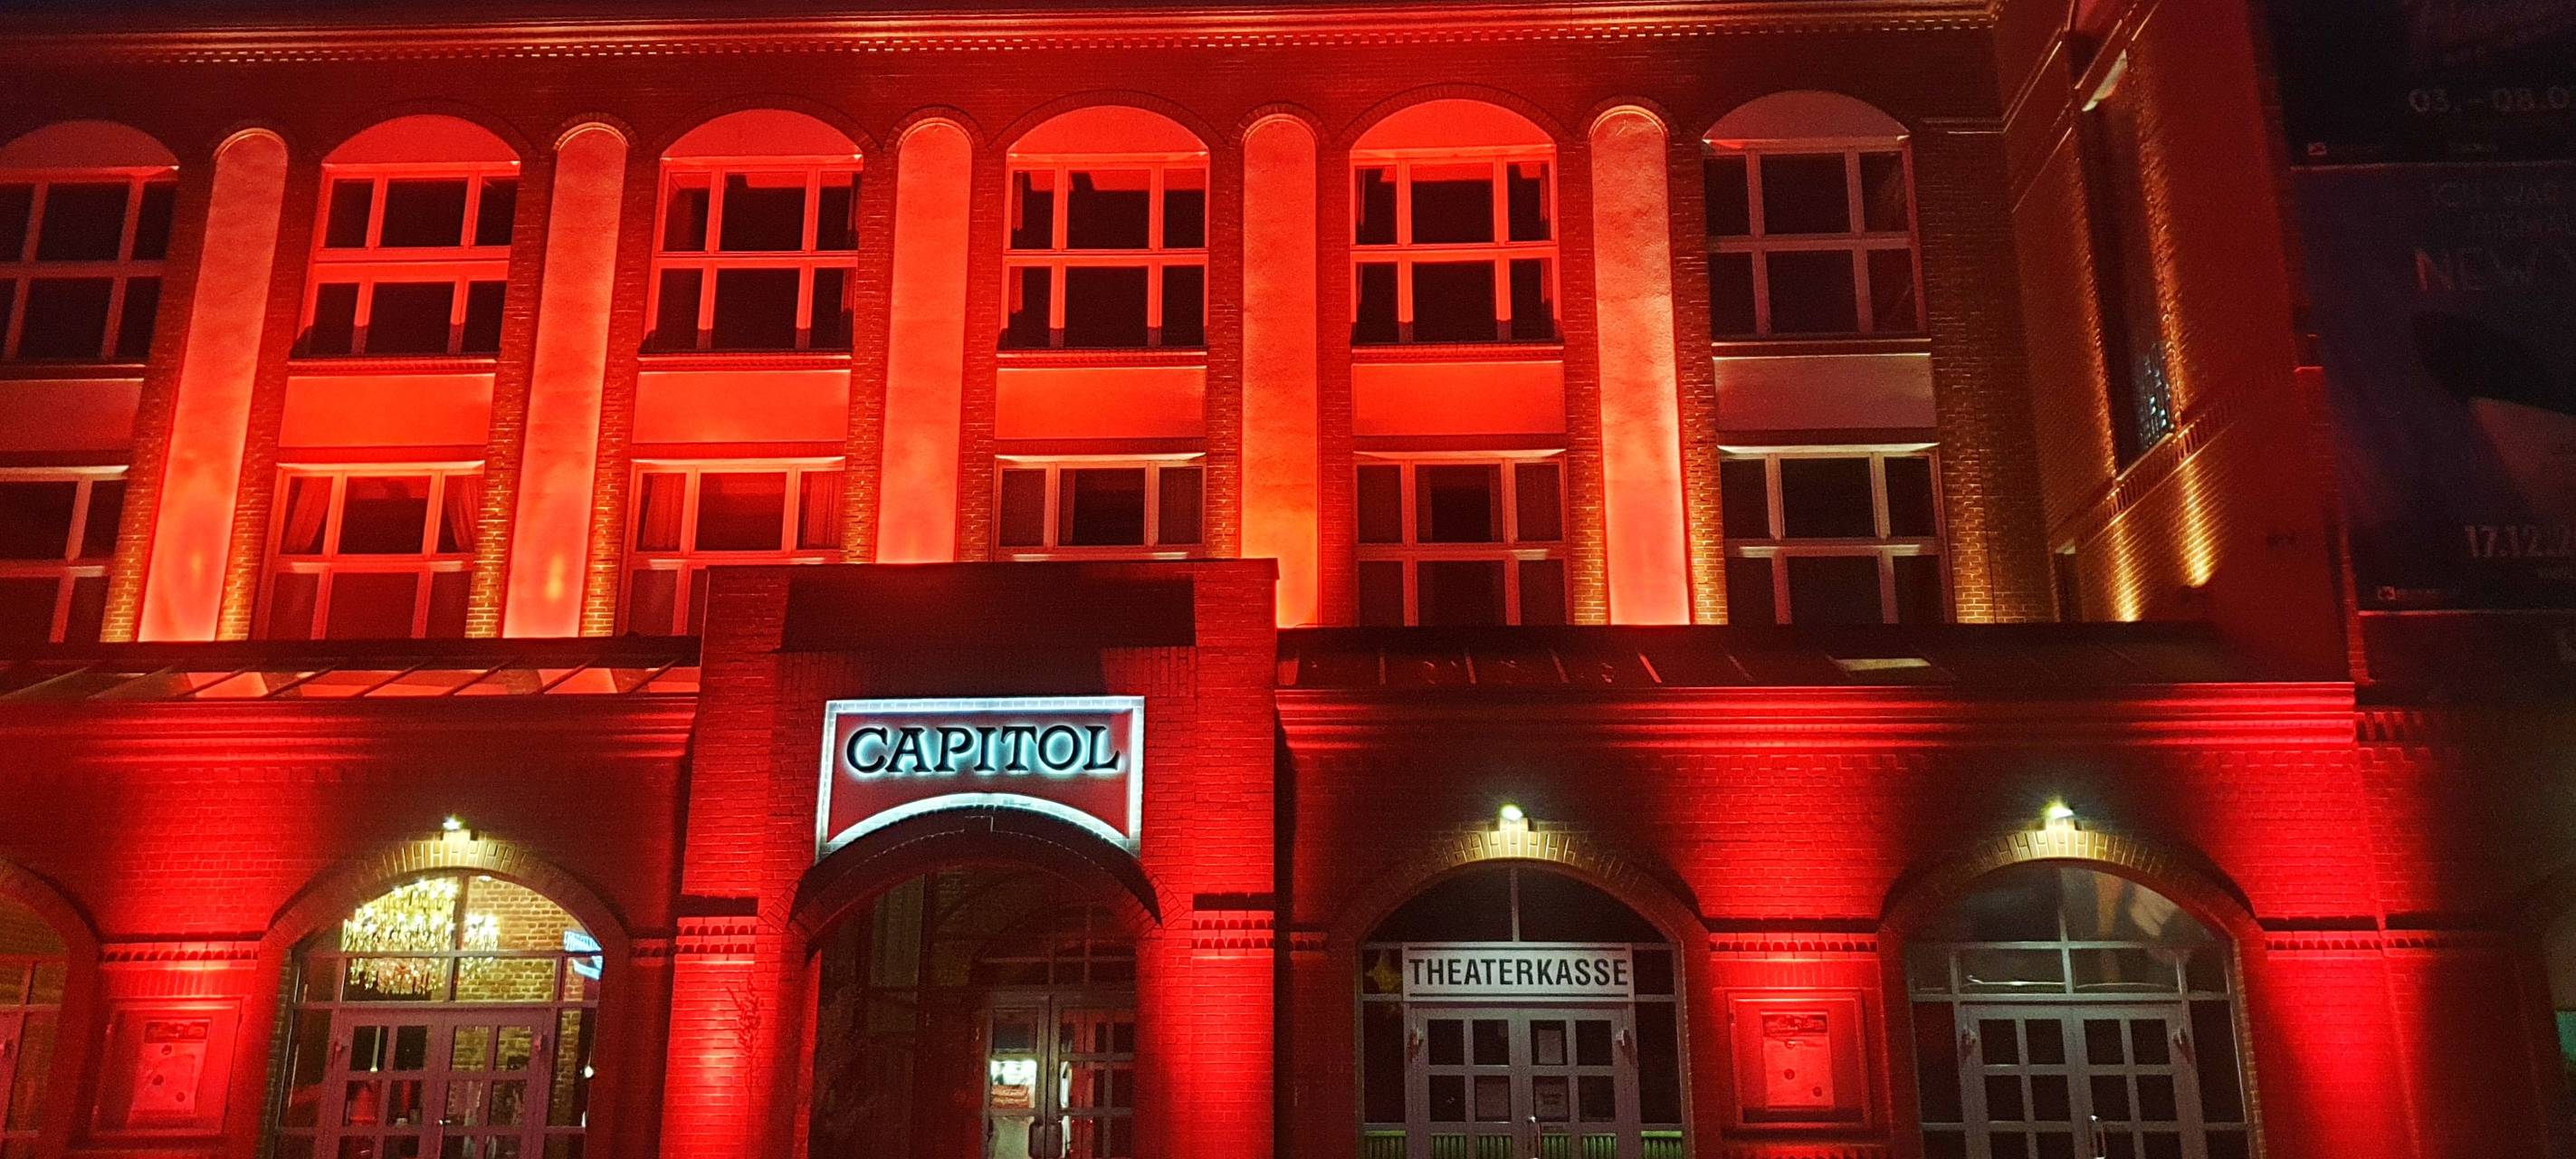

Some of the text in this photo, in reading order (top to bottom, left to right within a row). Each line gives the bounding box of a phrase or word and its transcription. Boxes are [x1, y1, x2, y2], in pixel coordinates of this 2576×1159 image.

[2413, 246, 2540, 292] NEW
[845, 723, 1121, 774] CAPITOL
[1408, 957, 1629, 987] THEATERKASSE
